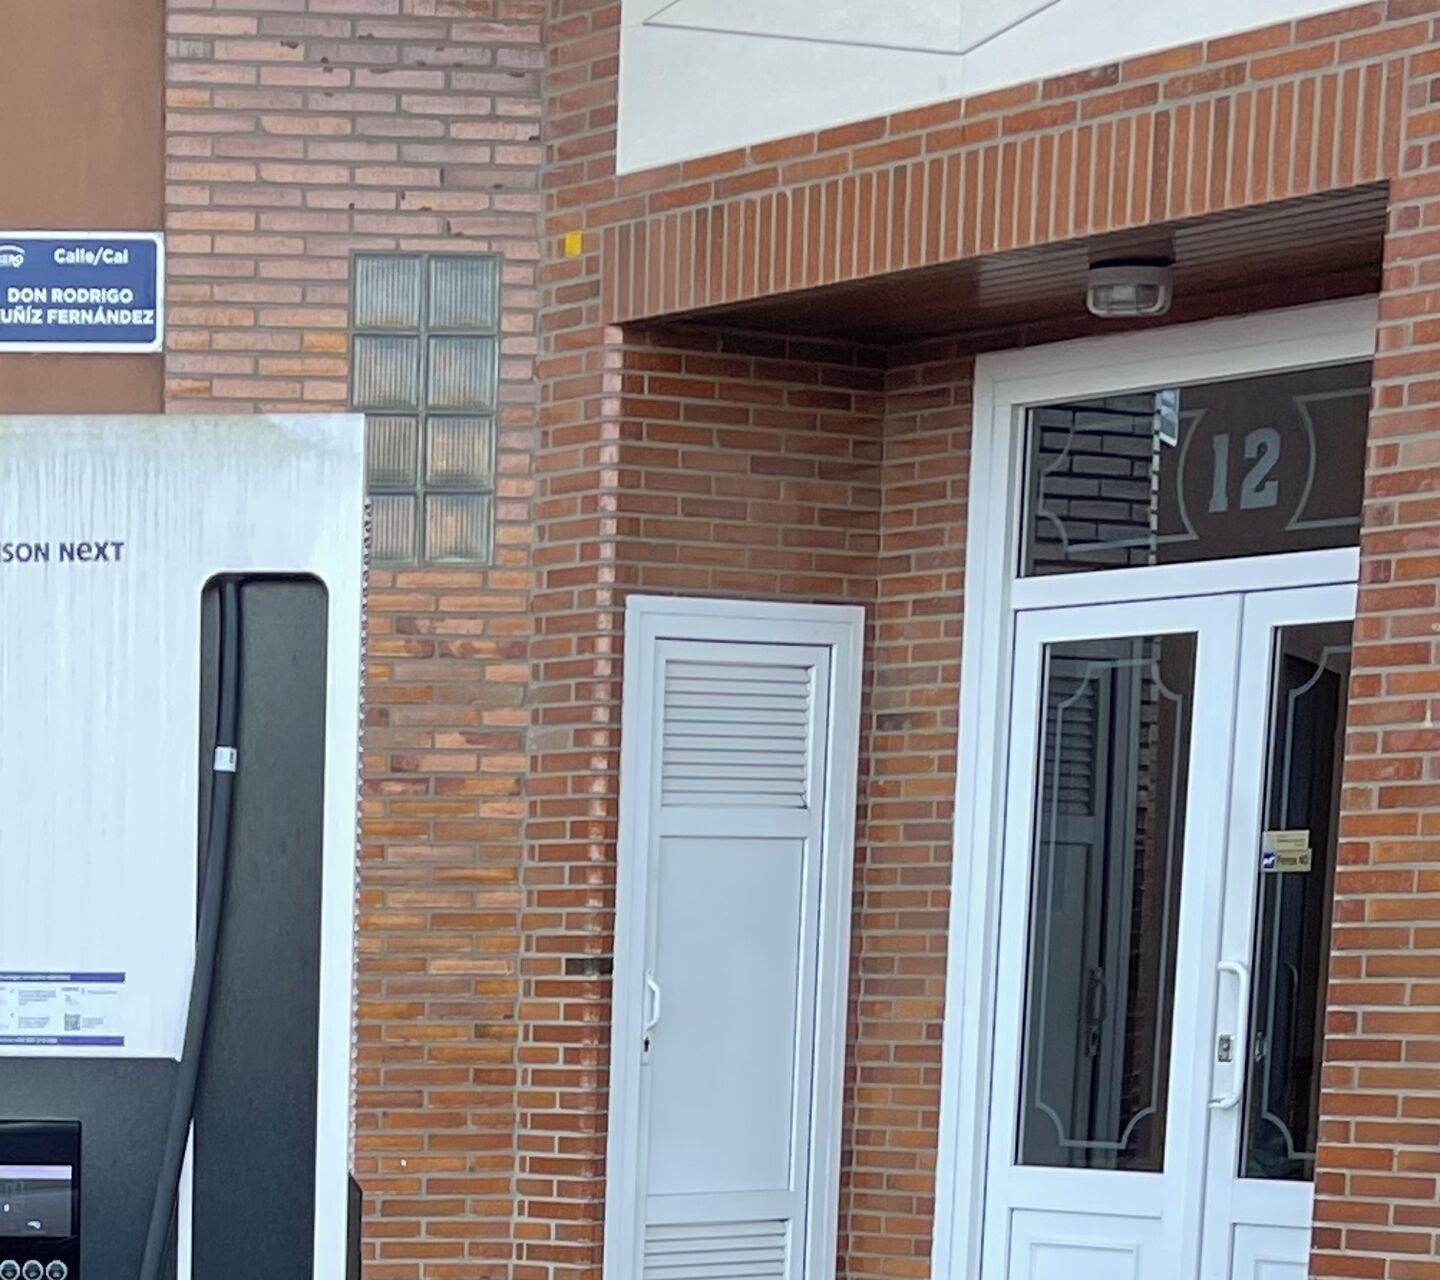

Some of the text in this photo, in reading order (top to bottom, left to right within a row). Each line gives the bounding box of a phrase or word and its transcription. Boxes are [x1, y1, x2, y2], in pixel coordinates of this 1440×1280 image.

[7, 287, 134, 304] DON RODRIGO
[47, 305, 154, 324] FERNÁNDEZ
[1209, 427, 1280, 512] 12
